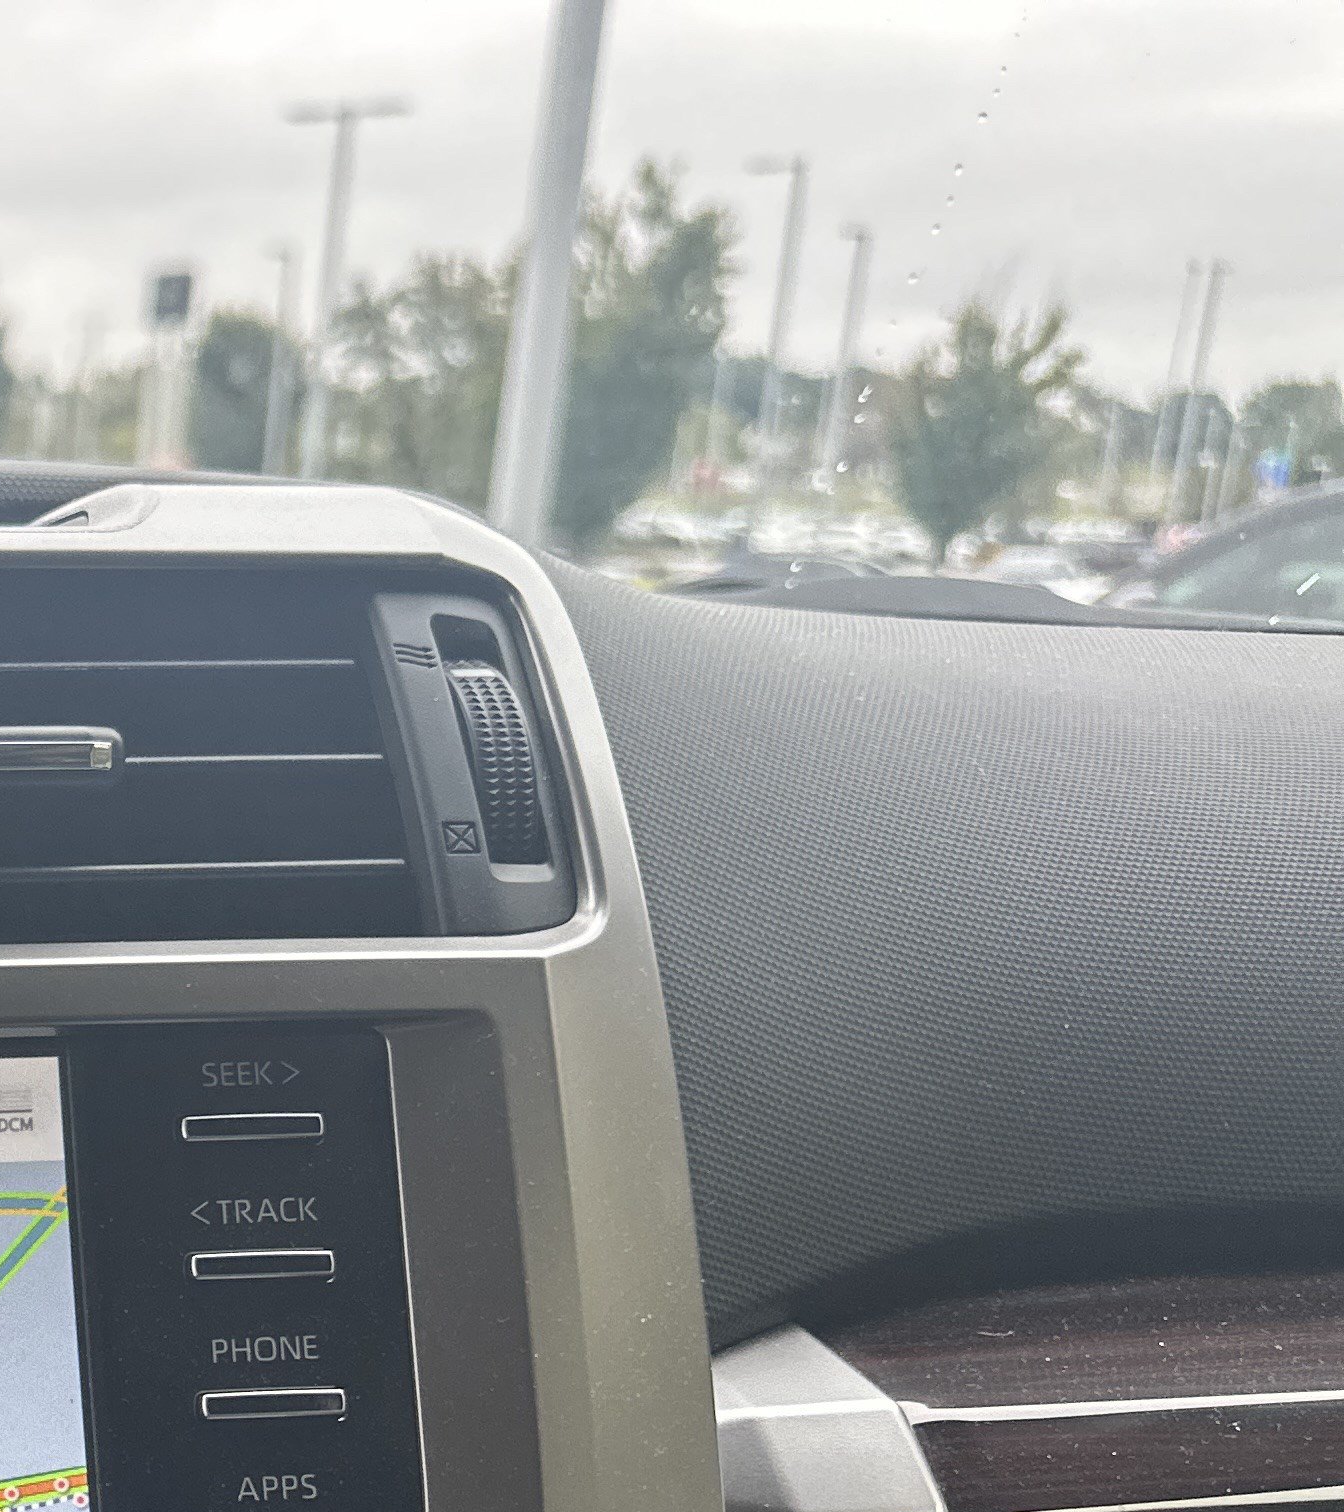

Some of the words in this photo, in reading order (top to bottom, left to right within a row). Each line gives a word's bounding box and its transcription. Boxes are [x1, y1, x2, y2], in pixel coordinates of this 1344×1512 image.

[201, 1062, 271, 1087] SEEK
[217, 1197, 318, 1225] TRACK
[212, 1335, 319, 1363] PHONE
[238, 1474, 318, 1501] APPS
